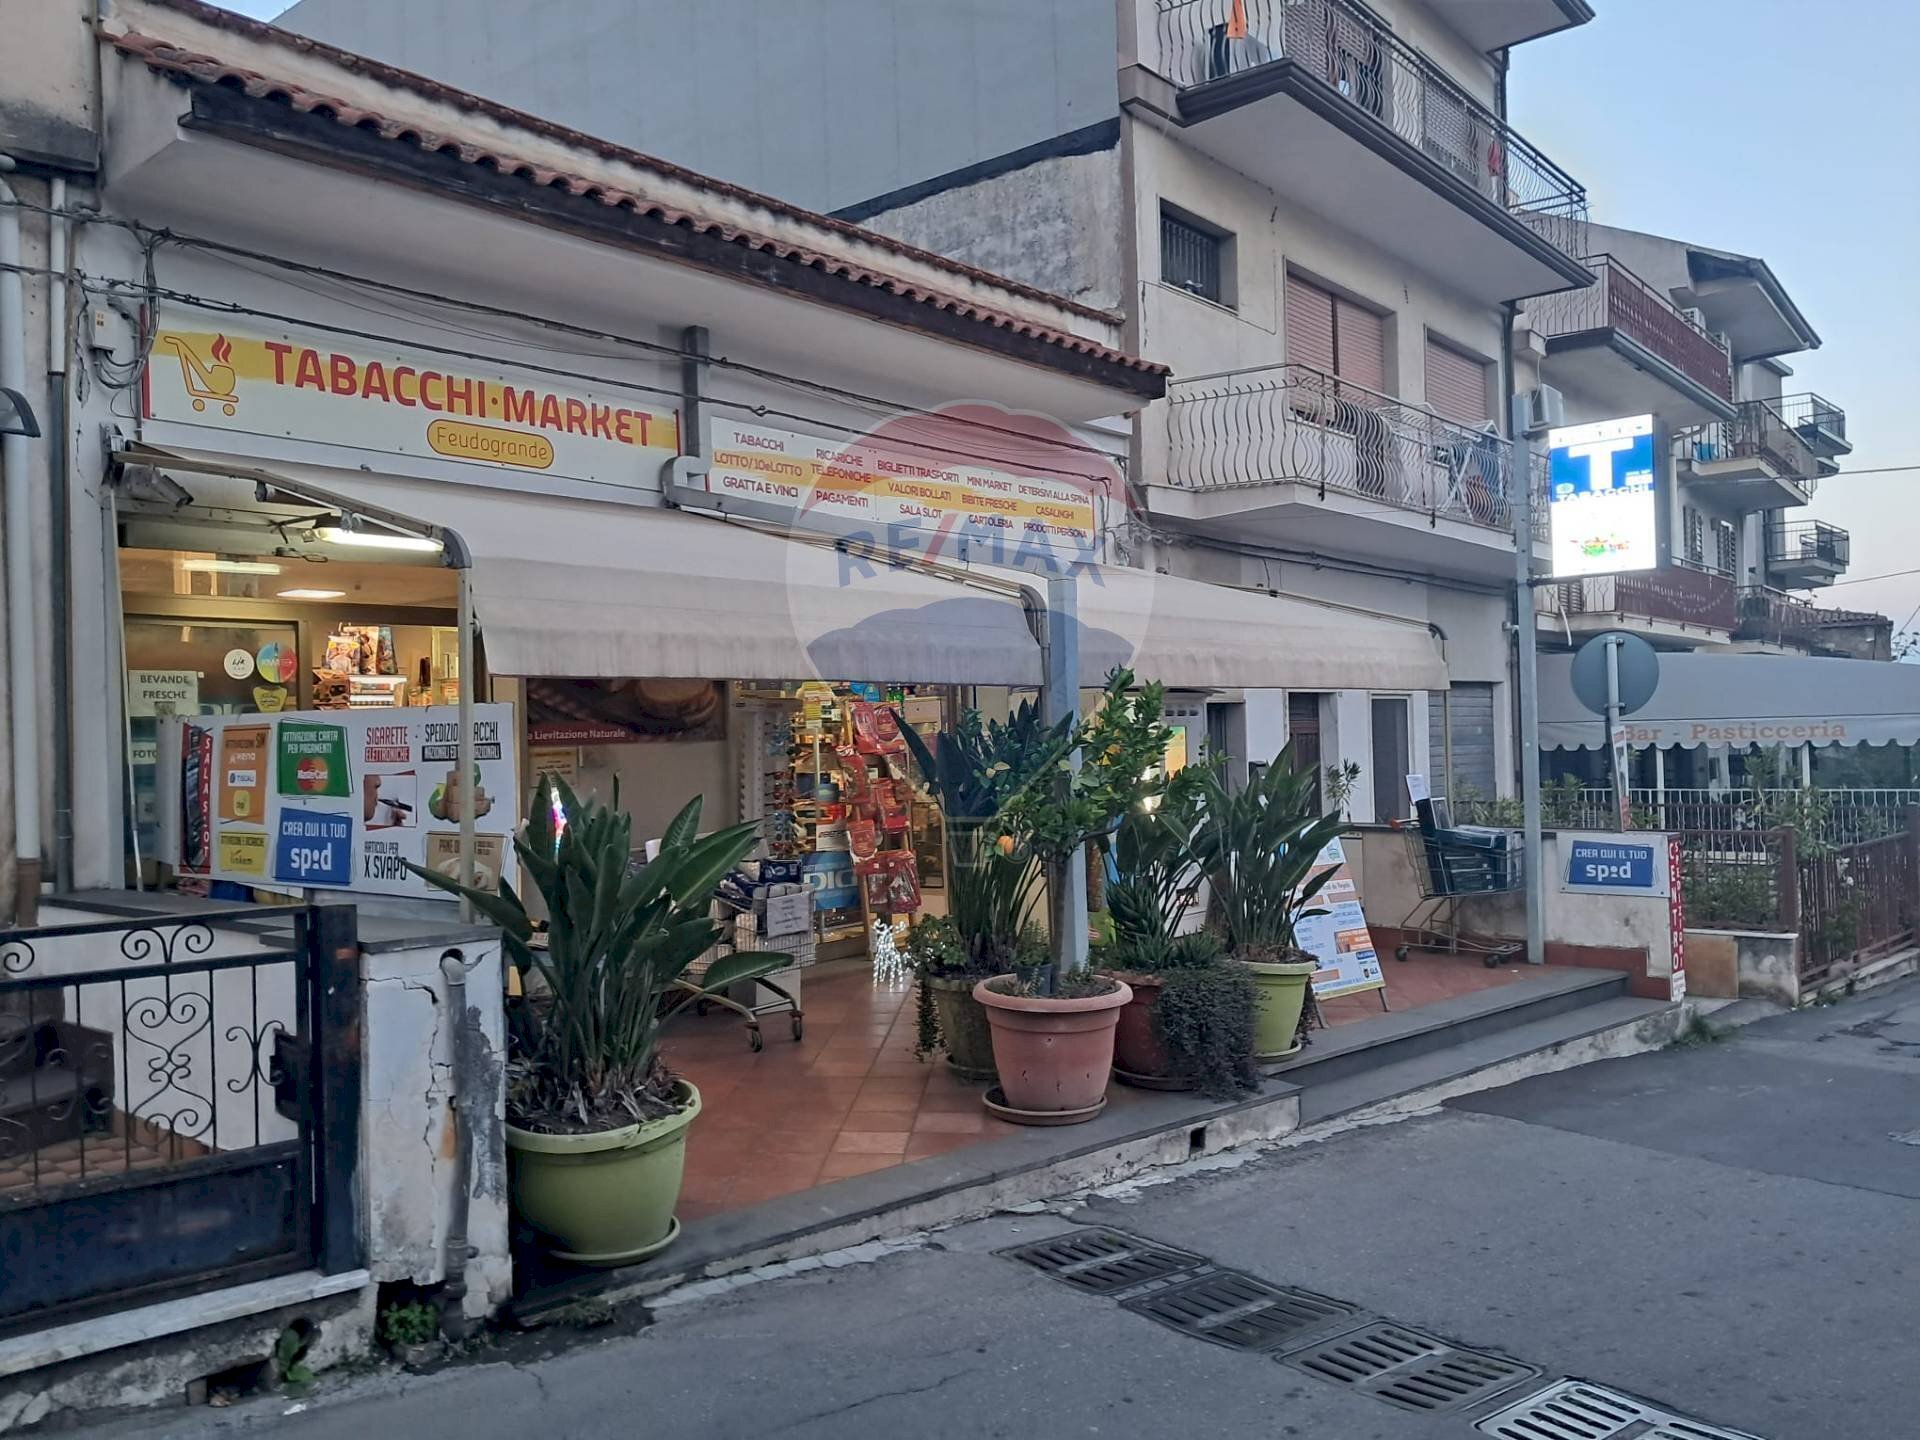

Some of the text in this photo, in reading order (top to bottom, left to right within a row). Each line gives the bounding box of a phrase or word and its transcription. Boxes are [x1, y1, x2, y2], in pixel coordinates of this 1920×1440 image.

[436, 426, 548, 461] Feudogrande
[733, 432, 784, 452] TABACCHI
[816, 448, 863, 466] RICARICHE
[810, 463, 871, 483] TELEFONICHE
[877, 460, 960, 483] BIGLIETTI TRASPORTI
[723, 476, 799, 498] GRATTA E VINCI
[888, 482, 951, 501] VALORI BOLLATI
[967, 476, 1012, 492] MINI MARKET
[816, 490, 868, 508] PAGAMENTI
[961, 494, 1017, 511] BIBITE FRESCHE
[1018, 484, 1090, 505] DETERSIVI ALLA SPINA
[899, 504, 942, 519] SALA SLOT
[1035, 506, 1074, 520] CASALINGHI
[968, 515, 1014, 529] CARTOLERIA
[1023, 521, 1088, 539] PRODOTTI PERSONA
[140, 675, 190, 684] BEVANDE
[143, 690, 187, 699] FRESCHE
[367, 726, 408, 745] SIGARETTE
[425, 722, 499, 742] SPEDIZIO ACCHI
[535, 730, 588, 740] Lievitazione
[589, 729, 626, 738] Naturale
[1625, 723, 1663, 742] Bar
[1691, 720, 1847, 742] Pasticceria
[287, 744, 298, 754] PER
[366, 748, 409, 761] ELETTRONICHE
[282, 822, 347, 838] CREA QUI IL TUO
[1576, 848, 1598, 858] CREA
[1601, 850, 1616, 859] QUI
[1630, 850, 1647, 860] TUO
[364, 855, 408, 881] X SVAPO
